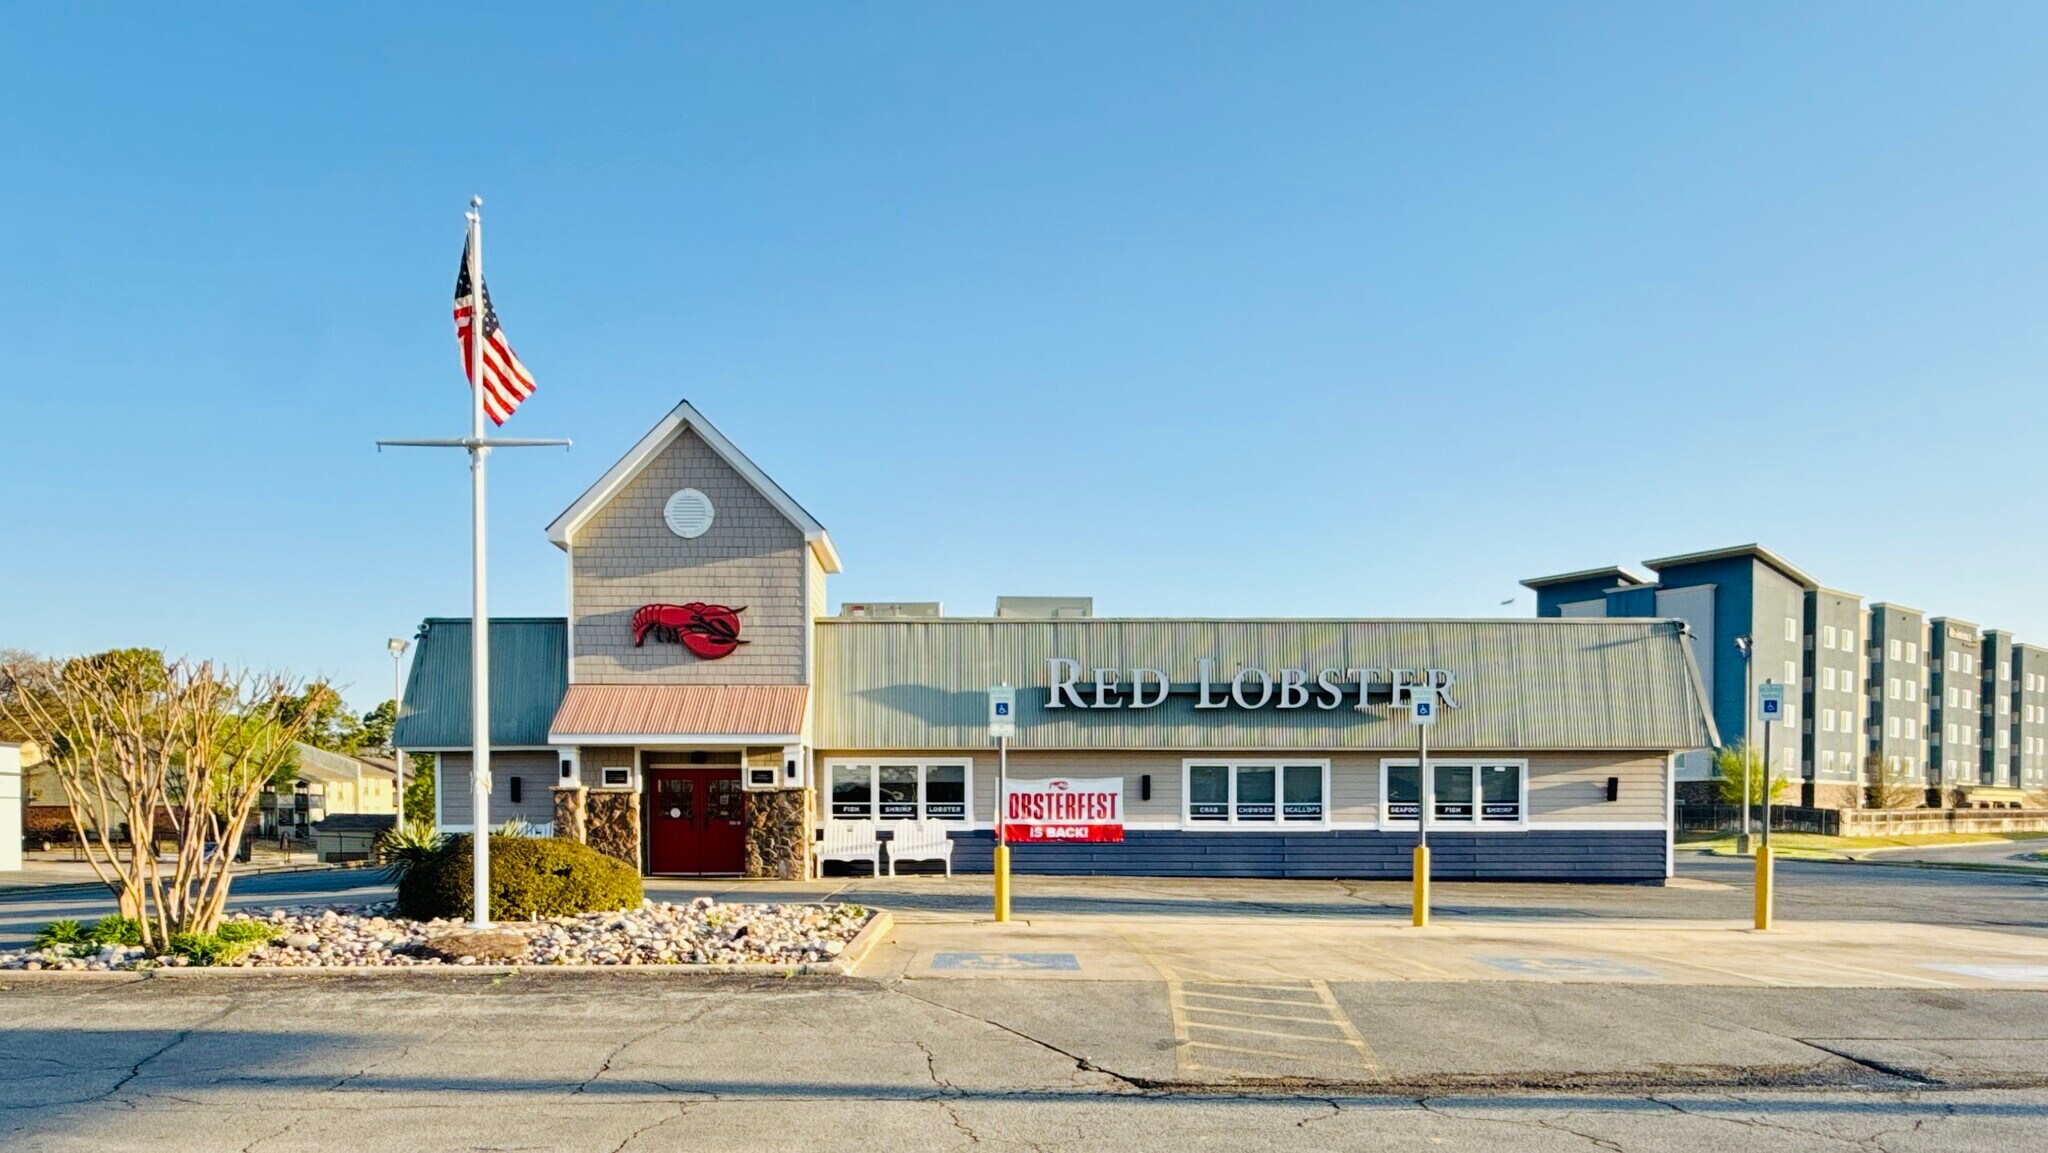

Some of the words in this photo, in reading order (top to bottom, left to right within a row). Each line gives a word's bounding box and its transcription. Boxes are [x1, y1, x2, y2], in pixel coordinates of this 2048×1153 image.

[1044, 657, 1169, 709] RED
[1194, 657, 1461, 710] LOBSTER
[1004, 792, 1118, 820] OBSTERFEST
[1199, 806, 1219, 814] CRAB
[1238, 806, 1274, 814] CHOWDER
[1444, 806, 1462, 814] FISH
[1486, 806, 1514, 814] SHRIMP
[1029, 826, 1043, 838] IS
[1046, 826, 1089, 838] BACK!
